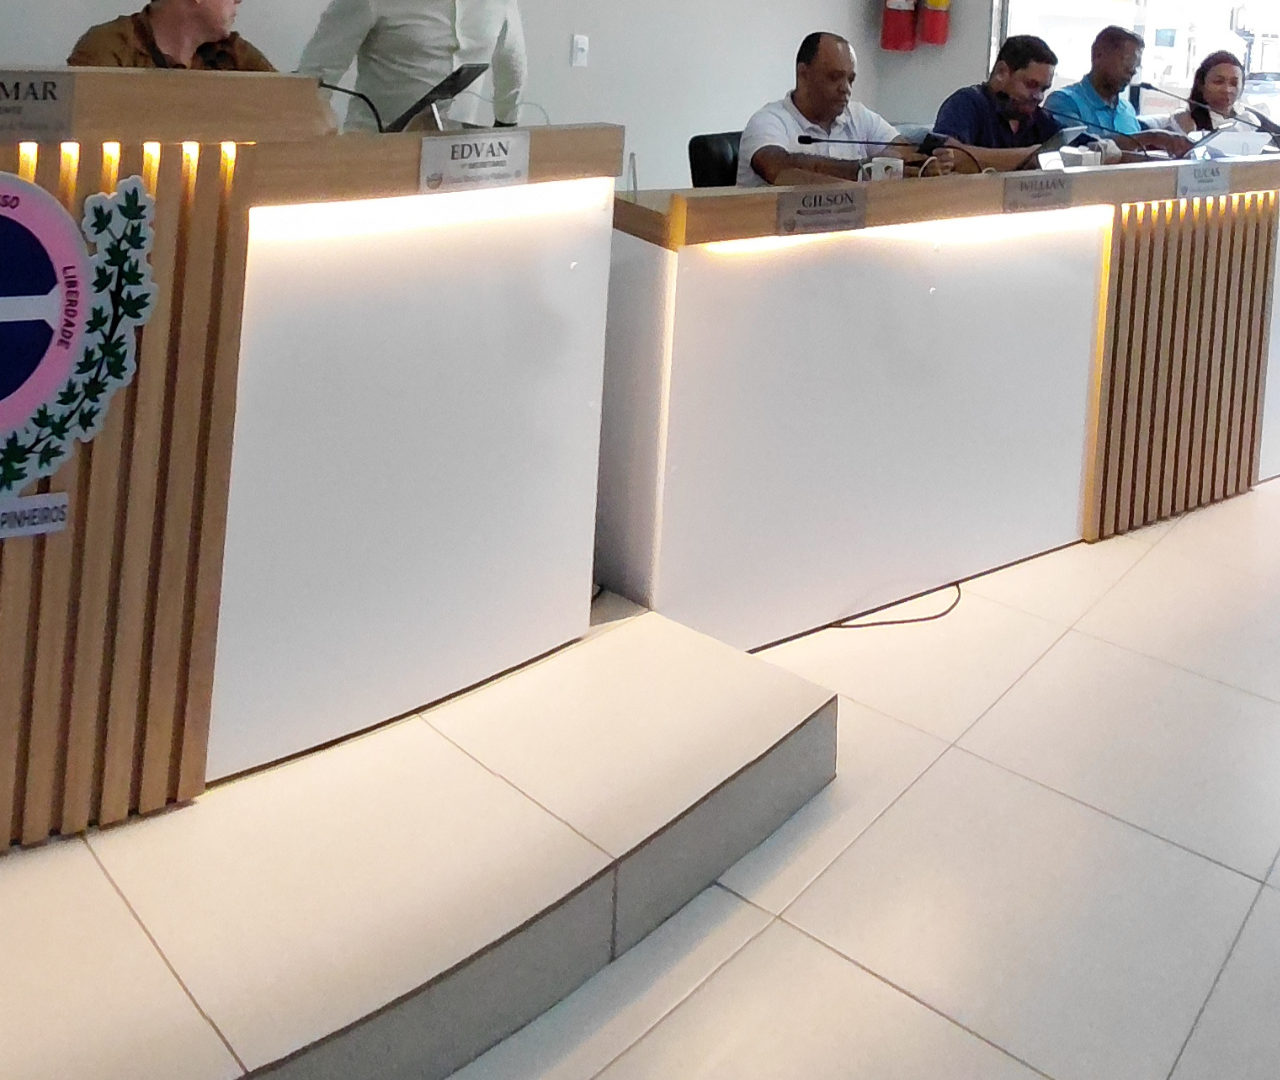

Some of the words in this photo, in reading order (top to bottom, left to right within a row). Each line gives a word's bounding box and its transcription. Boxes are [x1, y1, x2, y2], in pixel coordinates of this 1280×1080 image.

[450, 140, 510, 161] EDVAN
[801, 192, 855, 208] GILSON
[55, 265, 80, 350] LIBERDADE
[0, 504, 68, 530] PINHEIROS
